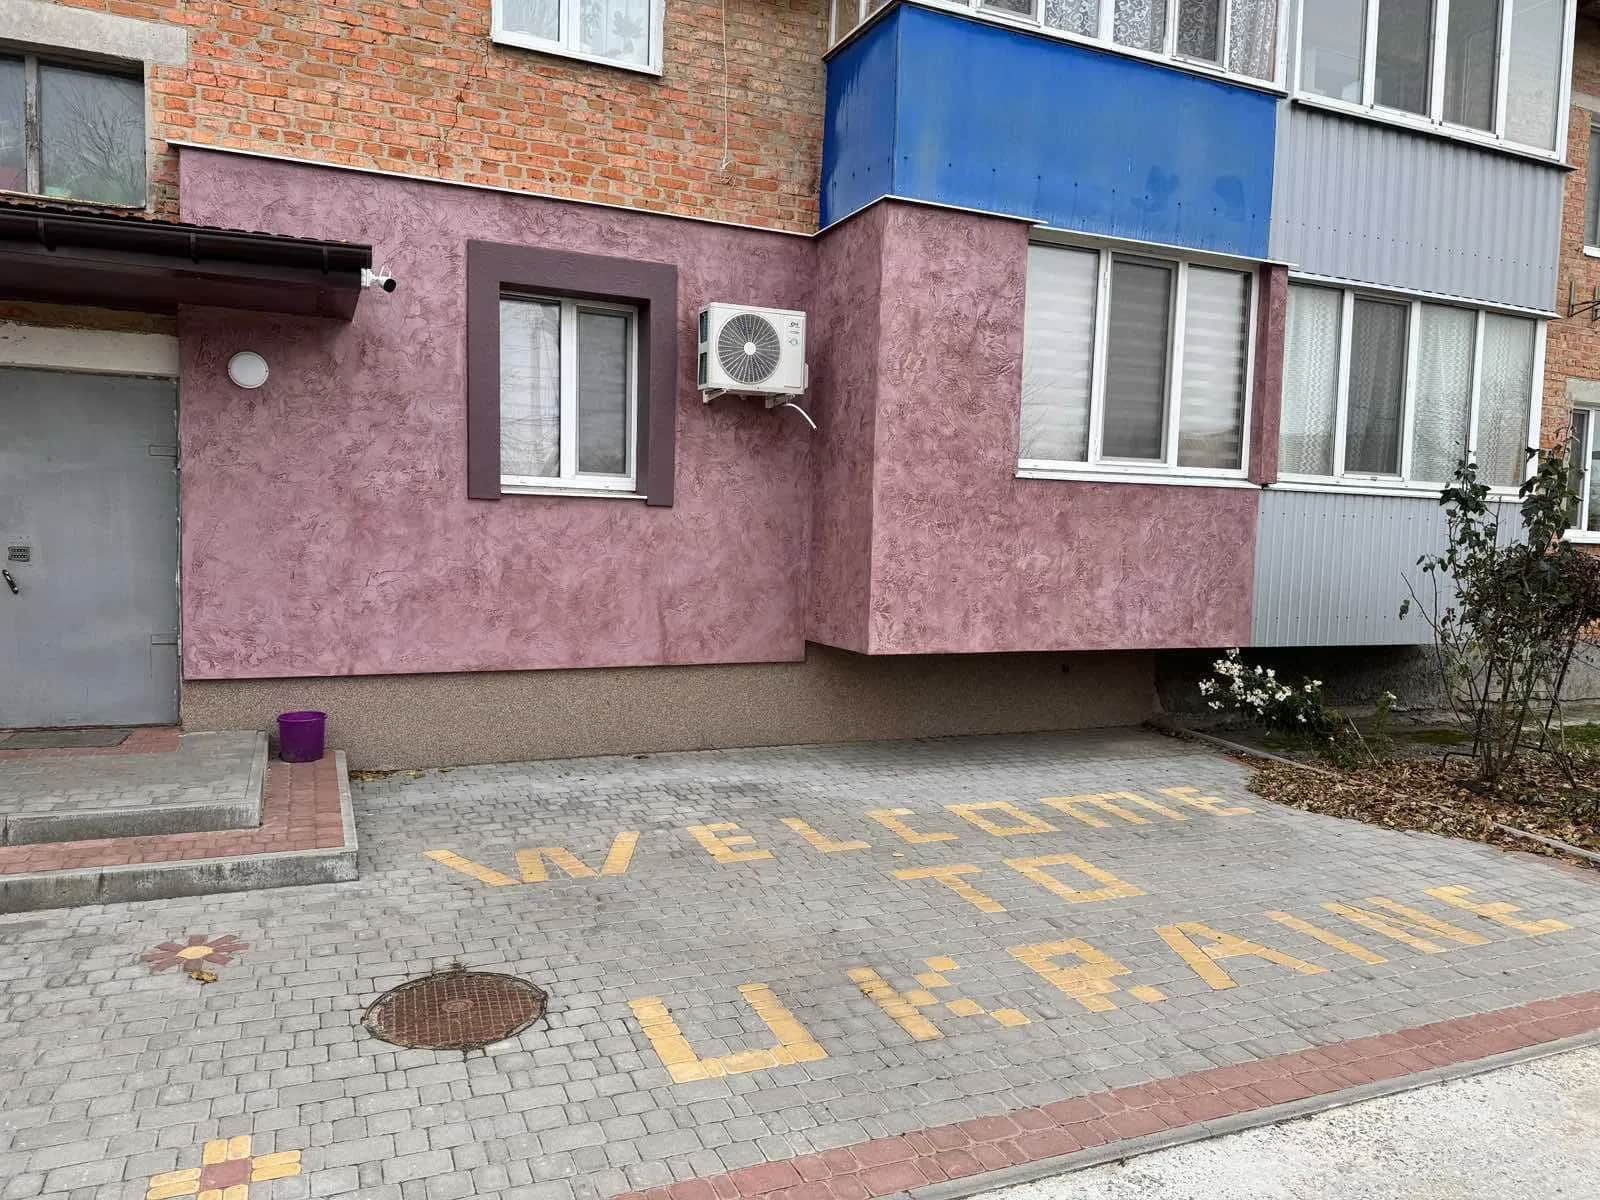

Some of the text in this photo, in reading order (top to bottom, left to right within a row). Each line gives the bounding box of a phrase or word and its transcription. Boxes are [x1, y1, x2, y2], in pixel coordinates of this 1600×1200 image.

[423, 787, 1255, 887] WELCOME
[894, 853, 1147, 913] TO
[628, 885, 1571, 1084] UKRAINE
